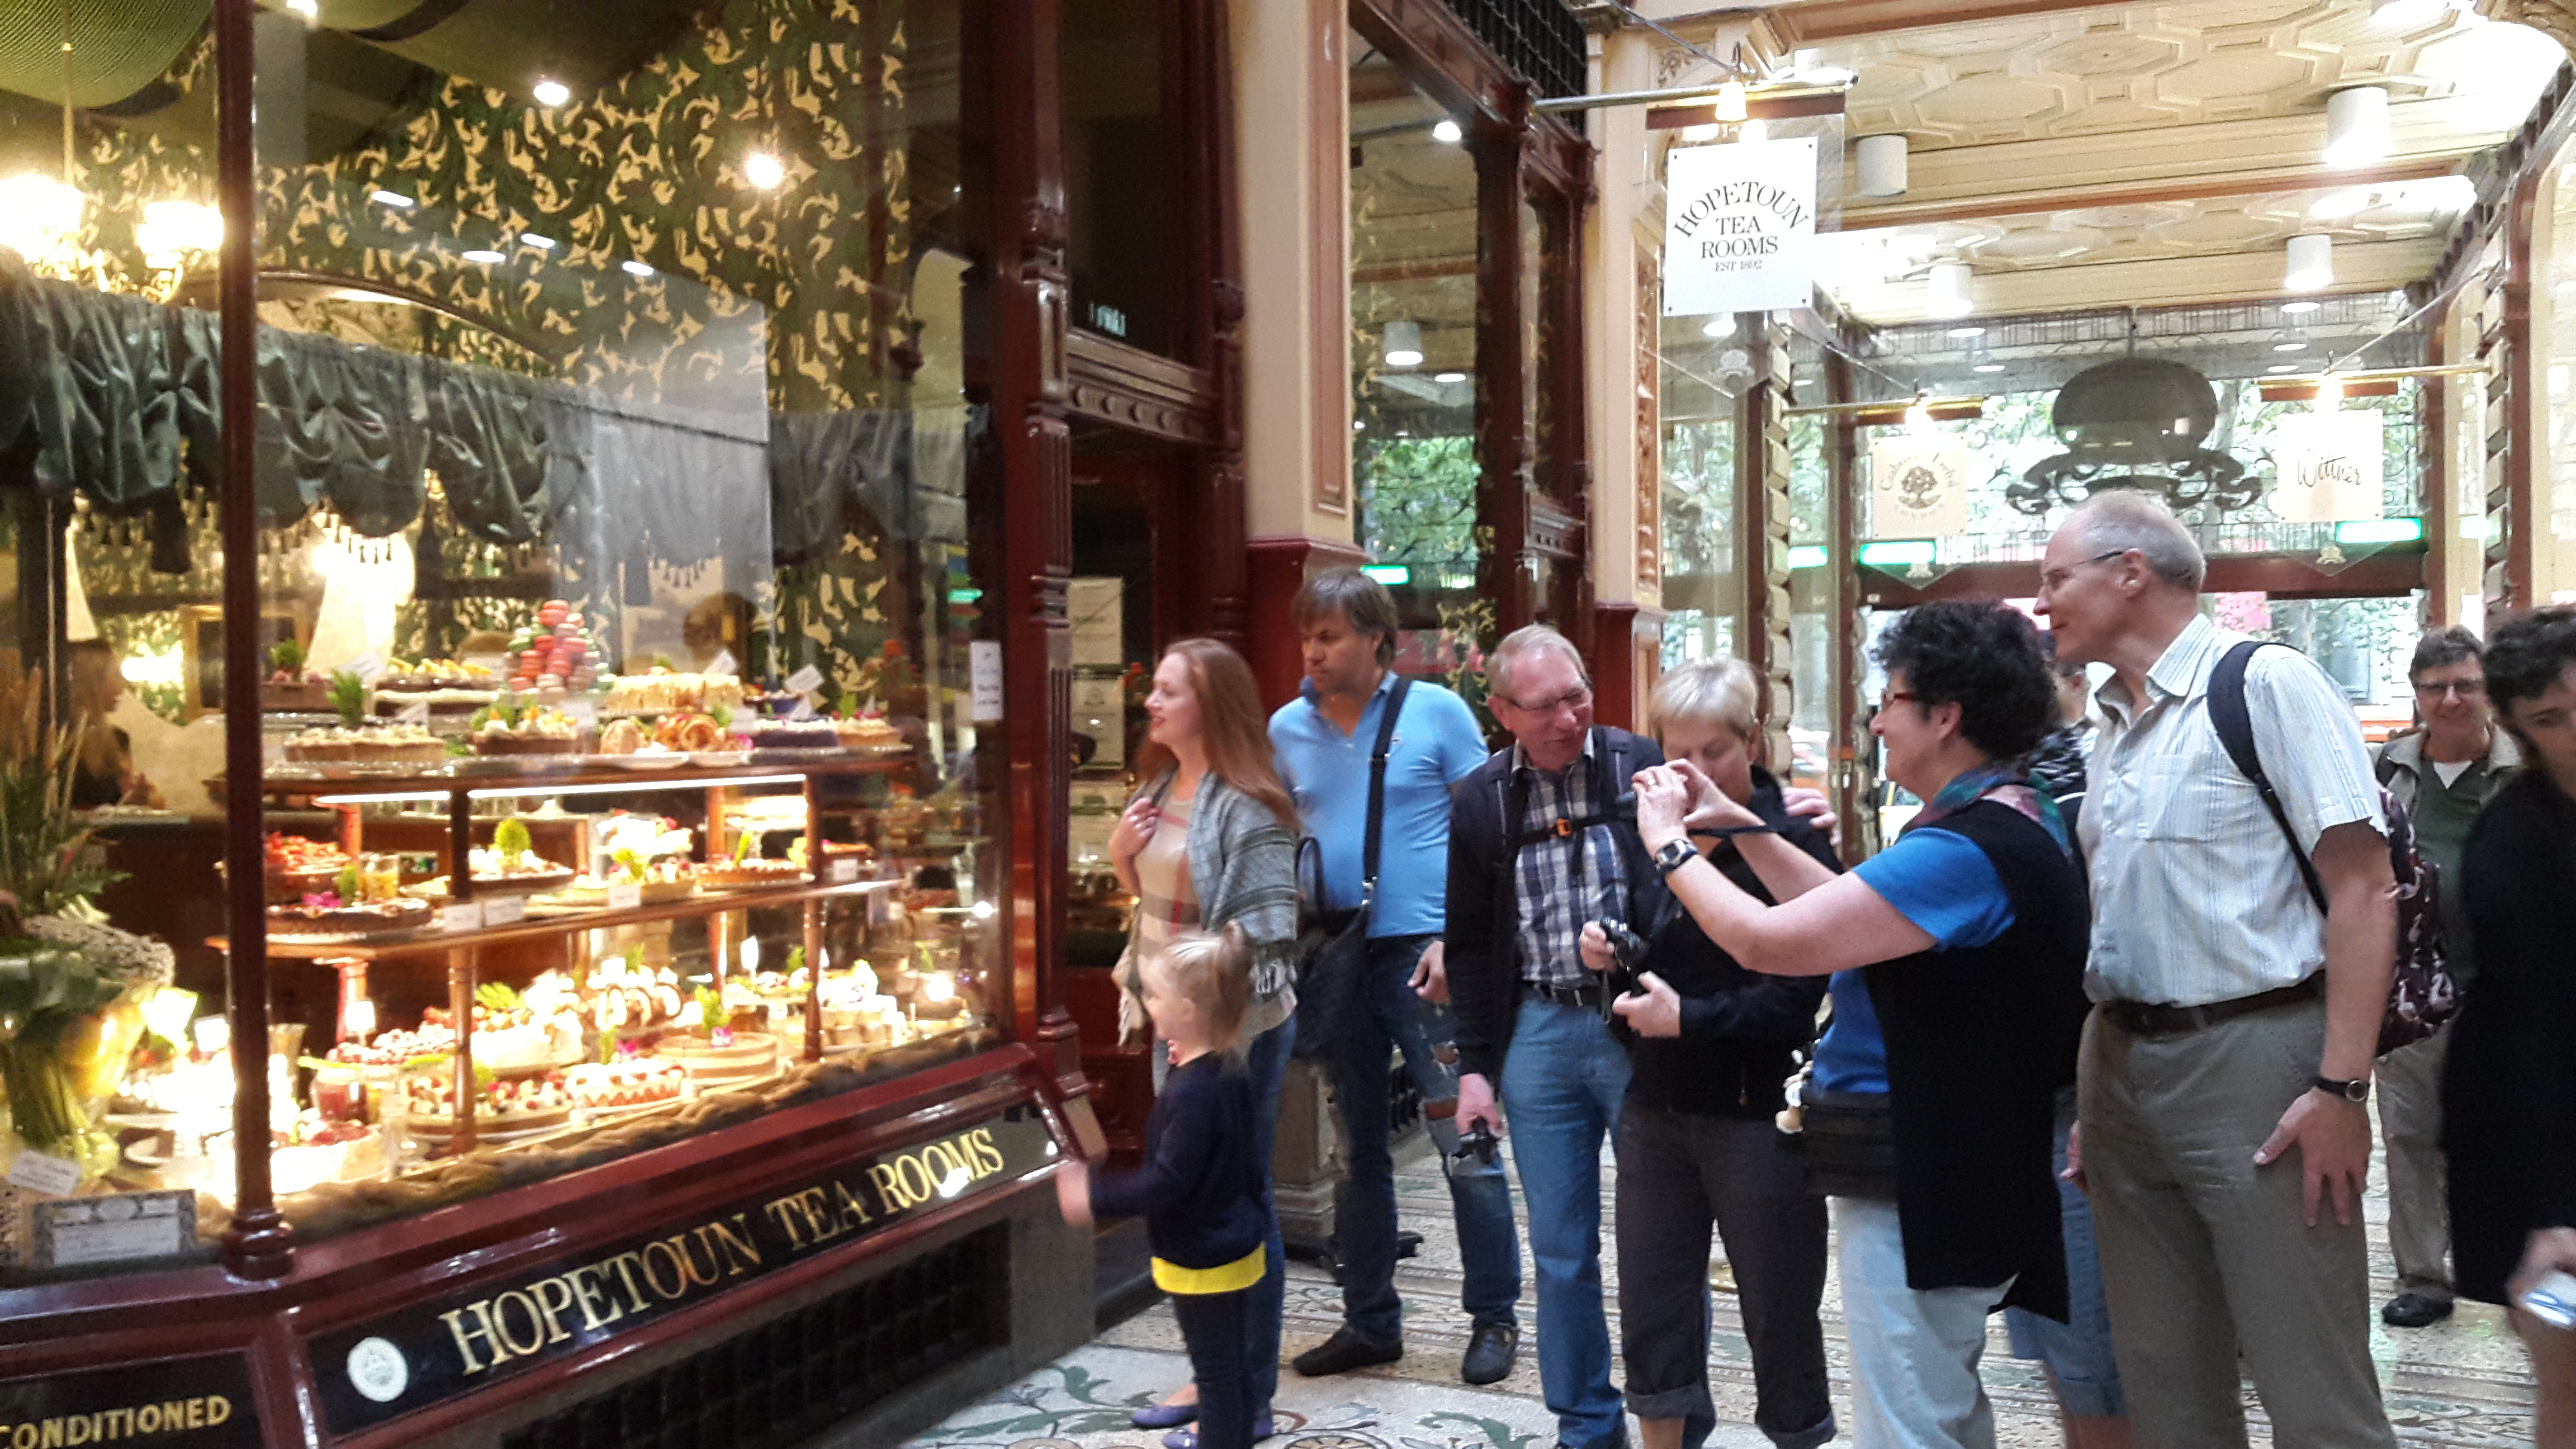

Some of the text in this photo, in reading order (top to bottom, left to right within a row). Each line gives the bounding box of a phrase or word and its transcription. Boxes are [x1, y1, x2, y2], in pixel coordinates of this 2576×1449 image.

[1673, 181, 1809, 238] HOPETOUN
[1715, 216, 1761, 235] TEA
[1701, 236, 1779, 259] ROOMS
[1715, 261, 1737, 272] EST
[438, 1126, 1005, 1376] HOPETOUN TEA ROOMS
